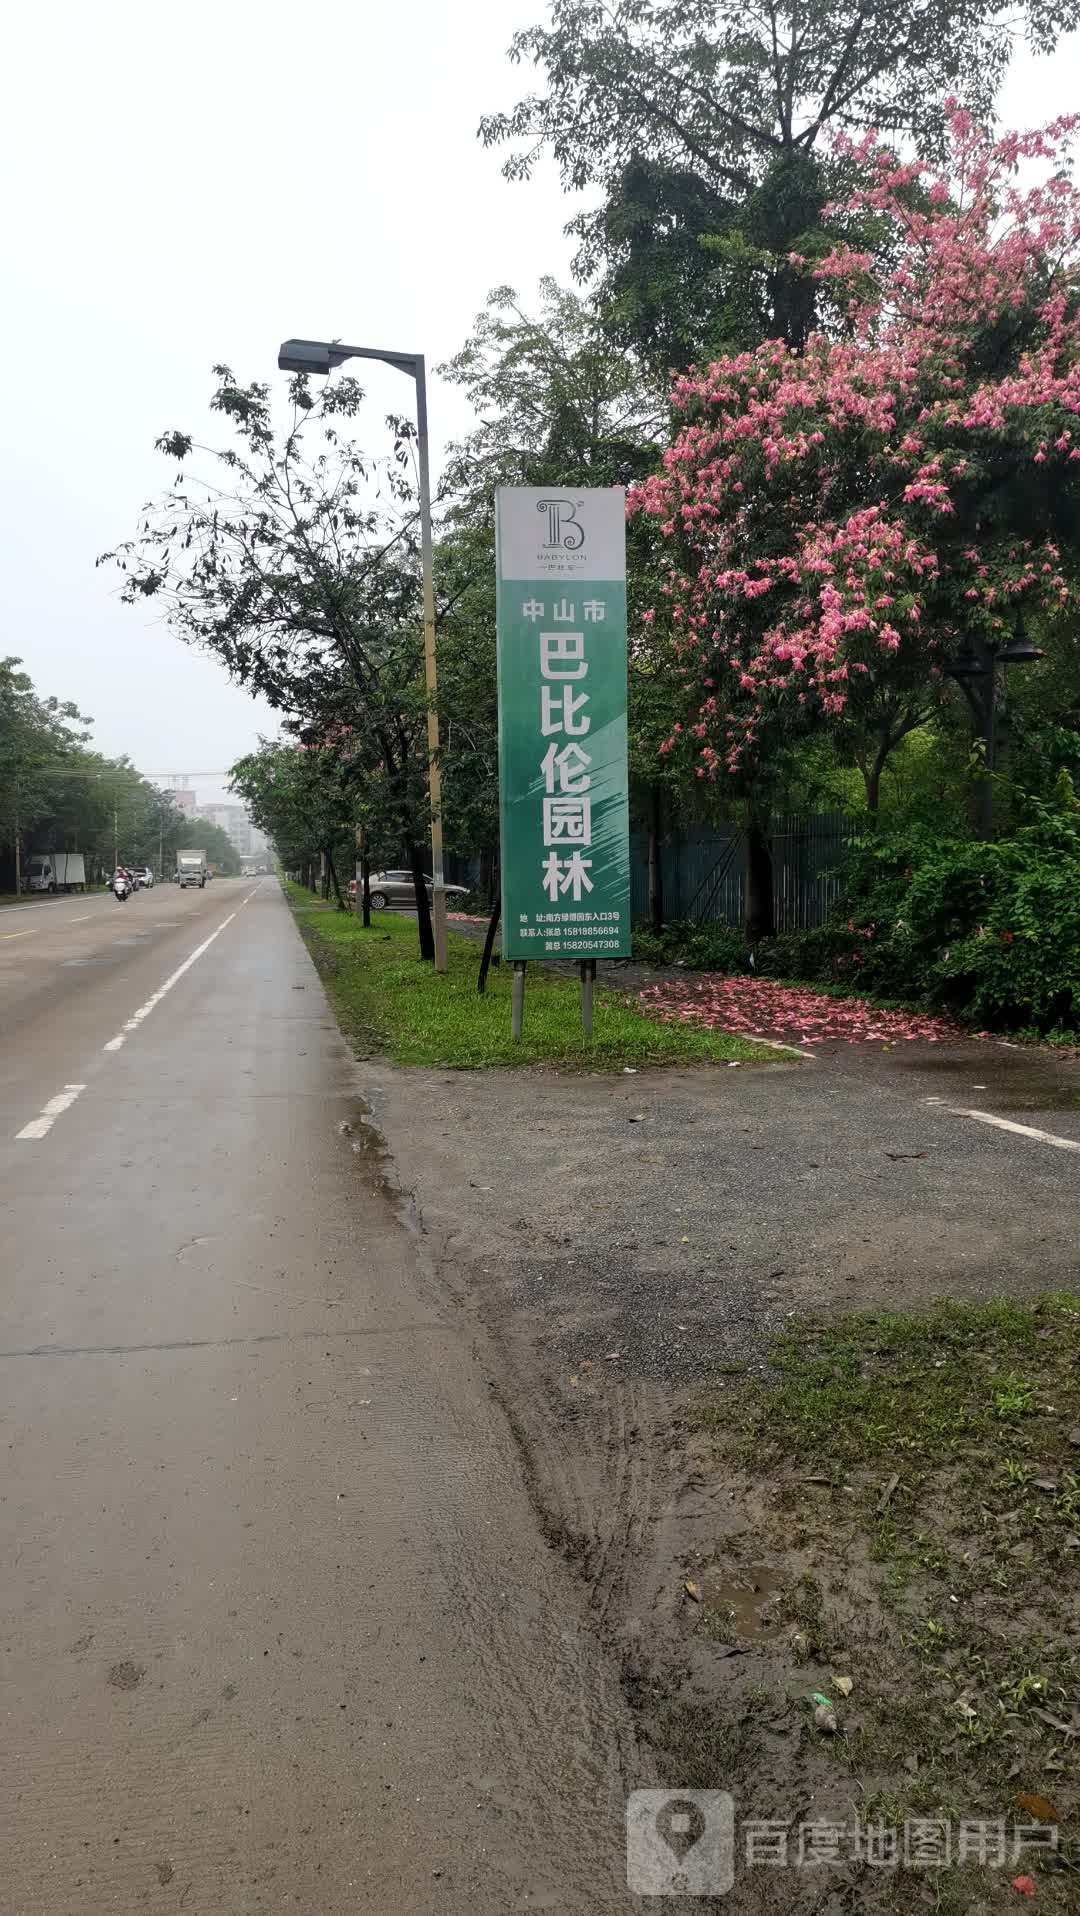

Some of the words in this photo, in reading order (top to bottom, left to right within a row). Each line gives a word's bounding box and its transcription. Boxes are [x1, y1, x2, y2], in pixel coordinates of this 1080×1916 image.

[522, 598, 606, 623] 中山市
[539, 631, 594, 903] 巴比伦园林
[563, 940, 620, 950] 15820547308
